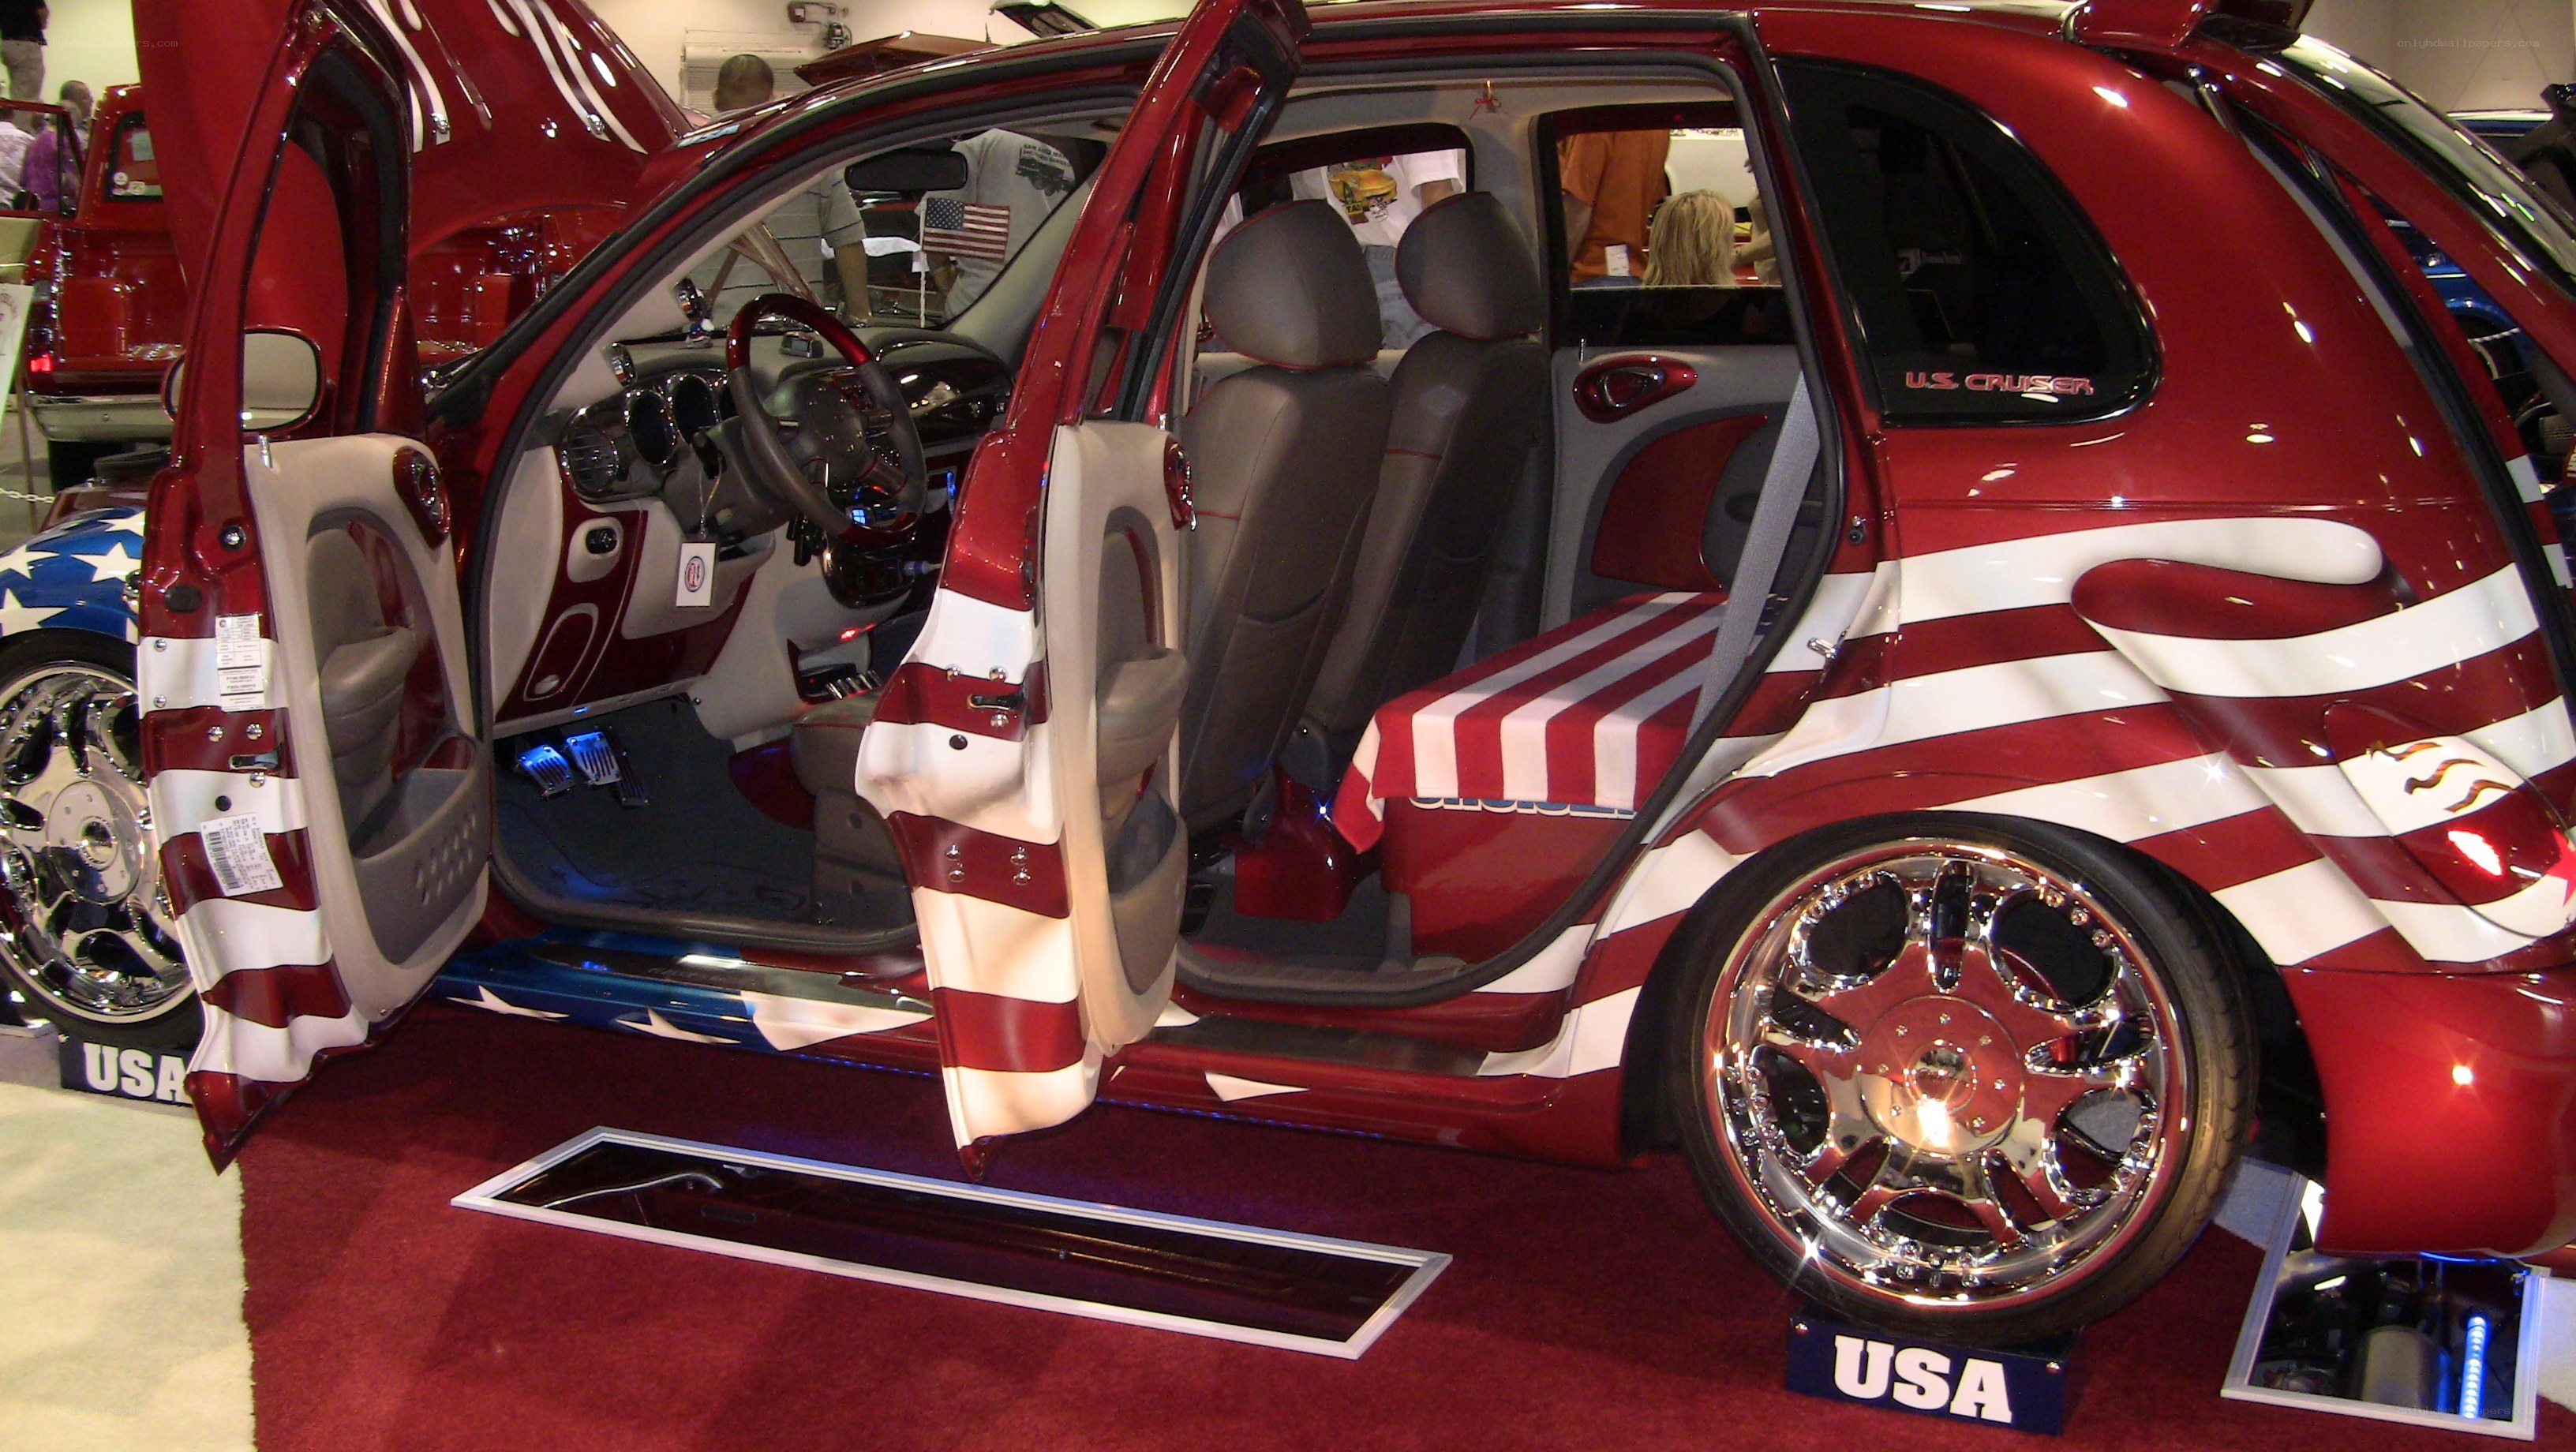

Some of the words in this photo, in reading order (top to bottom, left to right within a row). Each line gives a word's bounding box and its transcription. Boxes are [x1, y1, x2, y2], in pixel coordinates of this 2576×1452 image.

[1964, 373, 2094, 395] CRUISER
[83, 1042, 194, 1104] USA
[1834, 1334, 2012, 1424] USA
